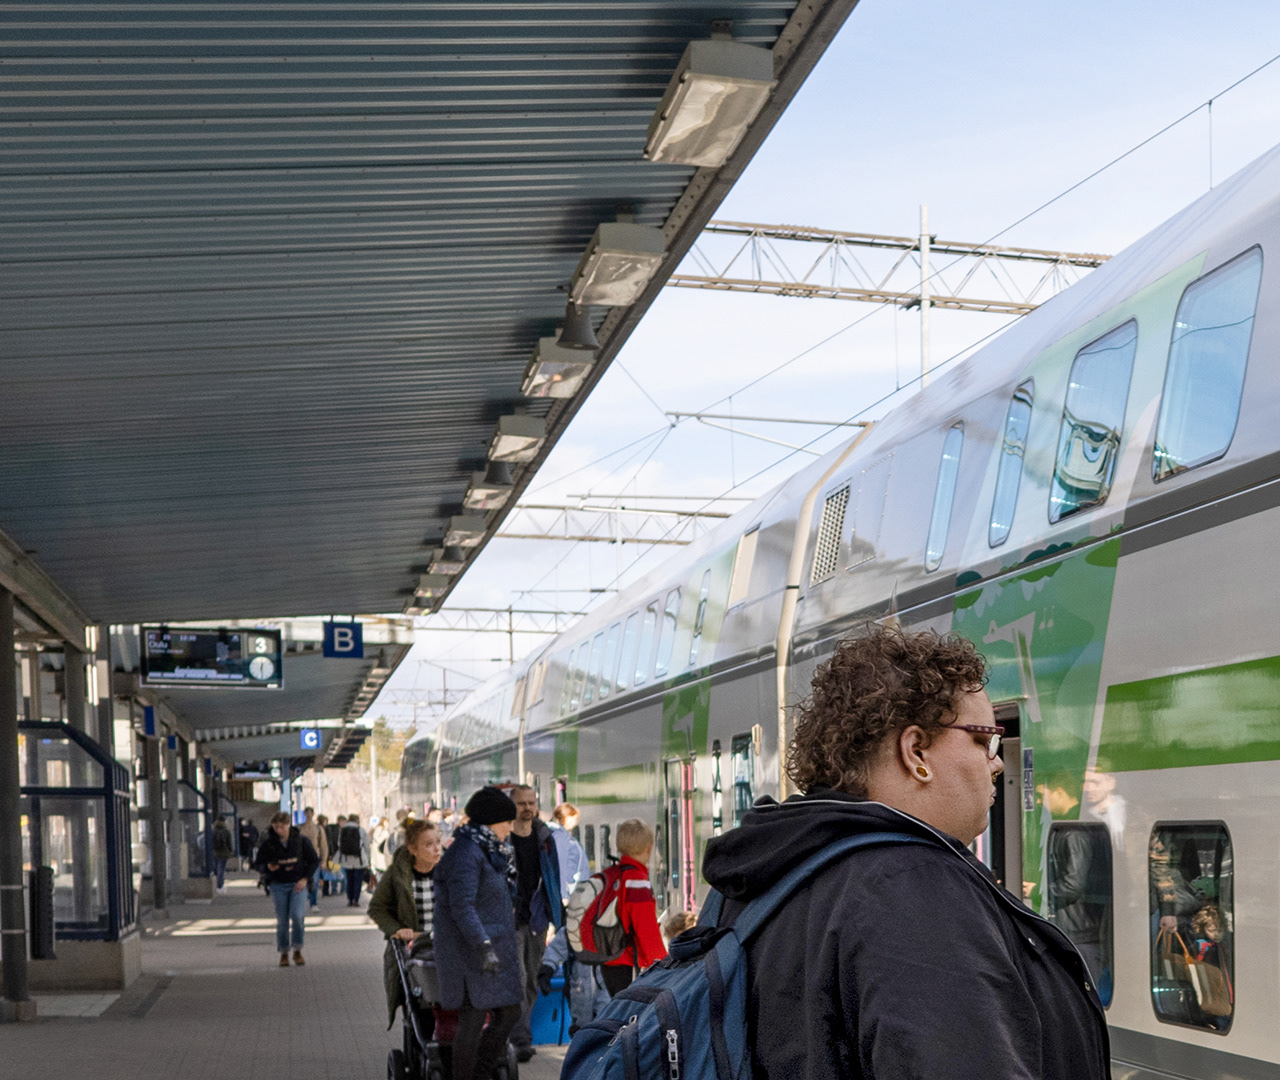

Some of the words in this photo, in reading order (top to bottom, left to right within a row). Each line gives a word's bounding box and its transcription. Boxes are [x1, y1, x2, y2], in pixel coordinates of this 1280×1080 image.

[254, 637, 268, 653] 3
[333, 628, 354, 652] B
[304, 731, 318, 747] C
